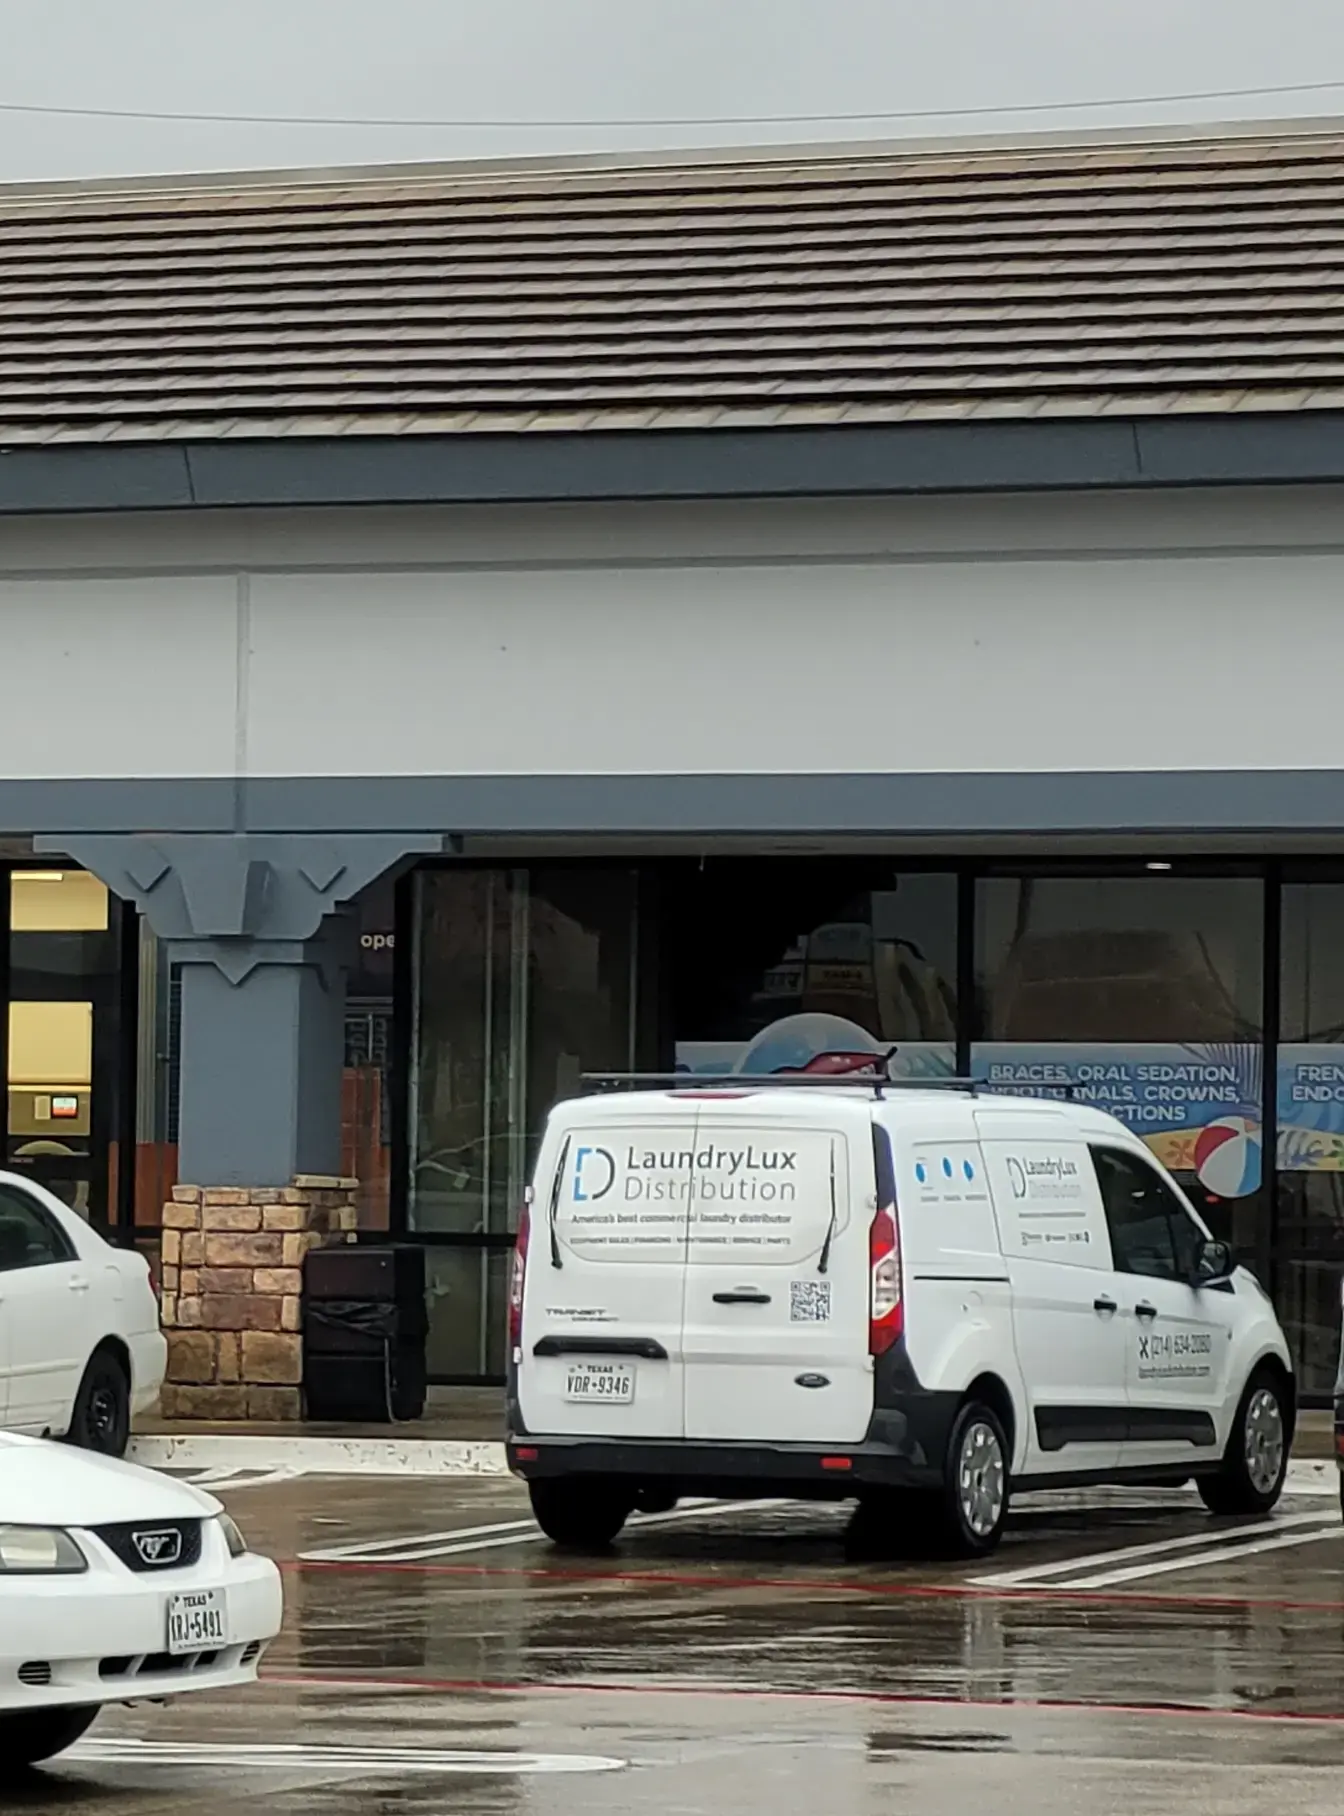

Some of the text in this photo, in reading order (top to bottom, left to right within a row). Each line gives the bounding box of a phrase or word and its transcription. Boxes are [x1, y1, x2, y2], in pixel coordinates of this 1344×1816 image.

[360, 934, 395, 951] ope
[1077, 1065, 1131, 1081] ORAL
[1137, 1065, 1241, 1084] SEDATION,
[1144, 1085, 1241, 1104] CROWNS,
[627, 1144, 797, 1176] LaundryLux
[624, 1175, 796, 1201] Distribution
[617, 1213, 638, 1224] best
[586, 1364, 614, 1374] TEXAS
[183, 1594, 207, 1608] TEXAS
